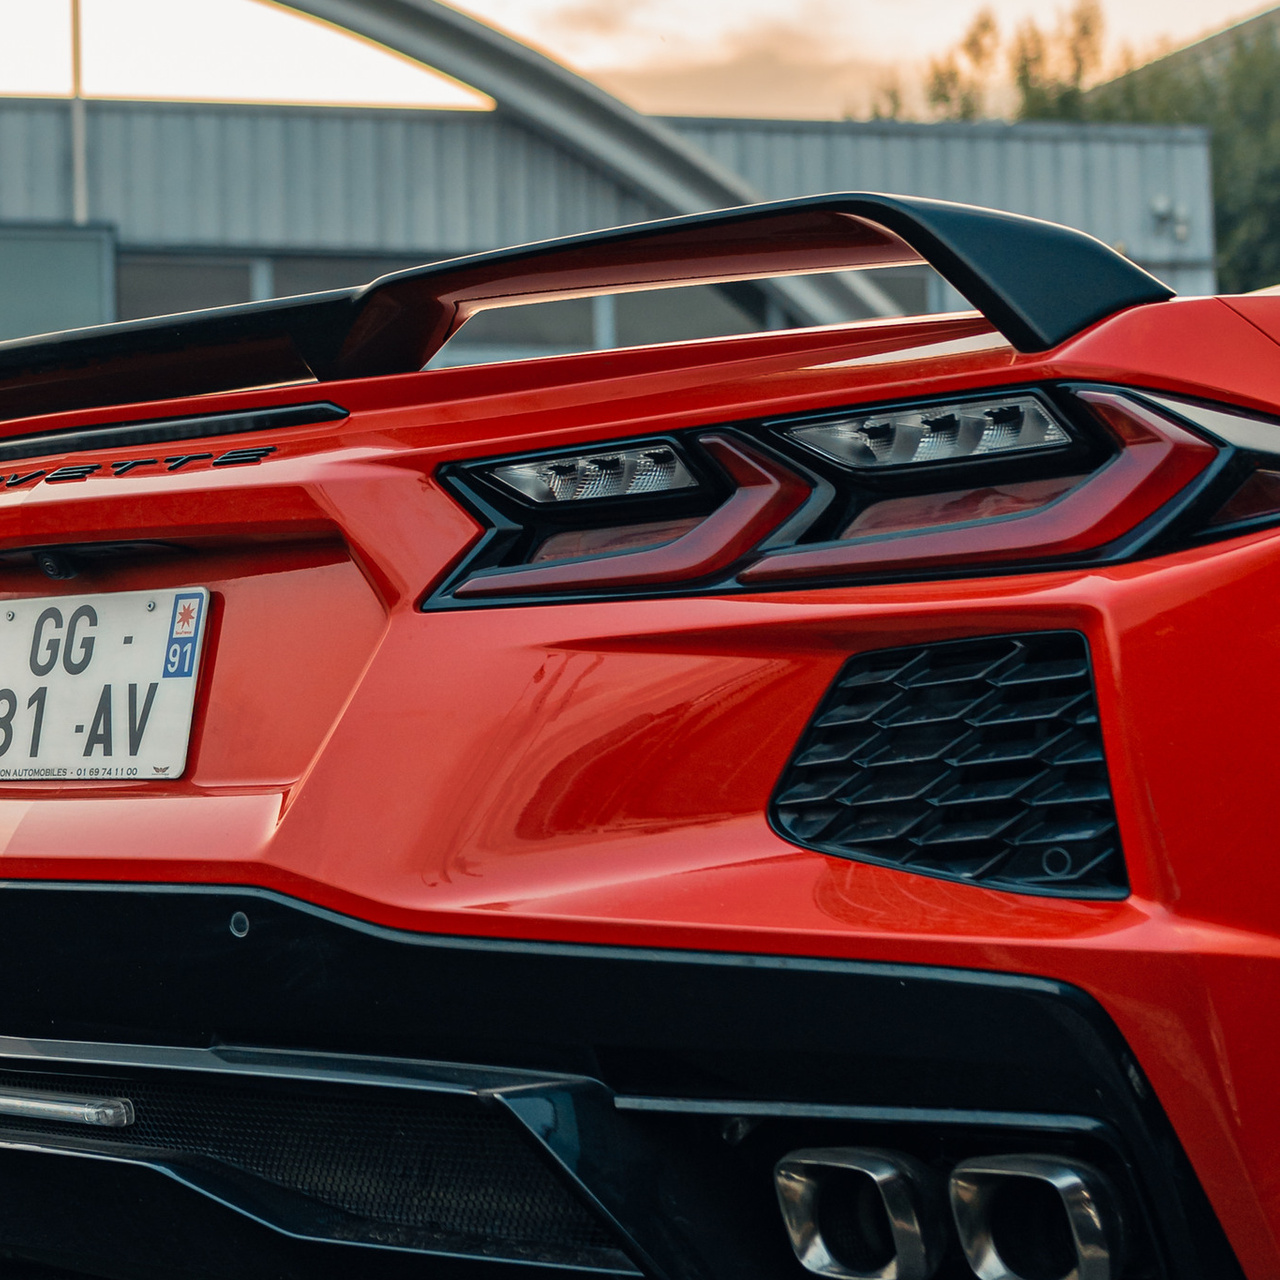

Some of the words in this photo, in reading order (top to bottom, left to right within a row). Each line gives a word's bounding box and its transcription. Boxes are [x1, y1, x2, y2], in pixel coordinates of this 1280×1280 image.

[29, 604, 98, 677] GG
[167, 642, 192, 673] 91
[12, 768, 68, 777] AUTOMOBILES
[76, 768, 87, 776] 01
[89, 768, 100, 776] 69
[102, 768, 112, 776] 74
[115, 768, 124, 776] 11
[126, 767, 138, 776] 00
